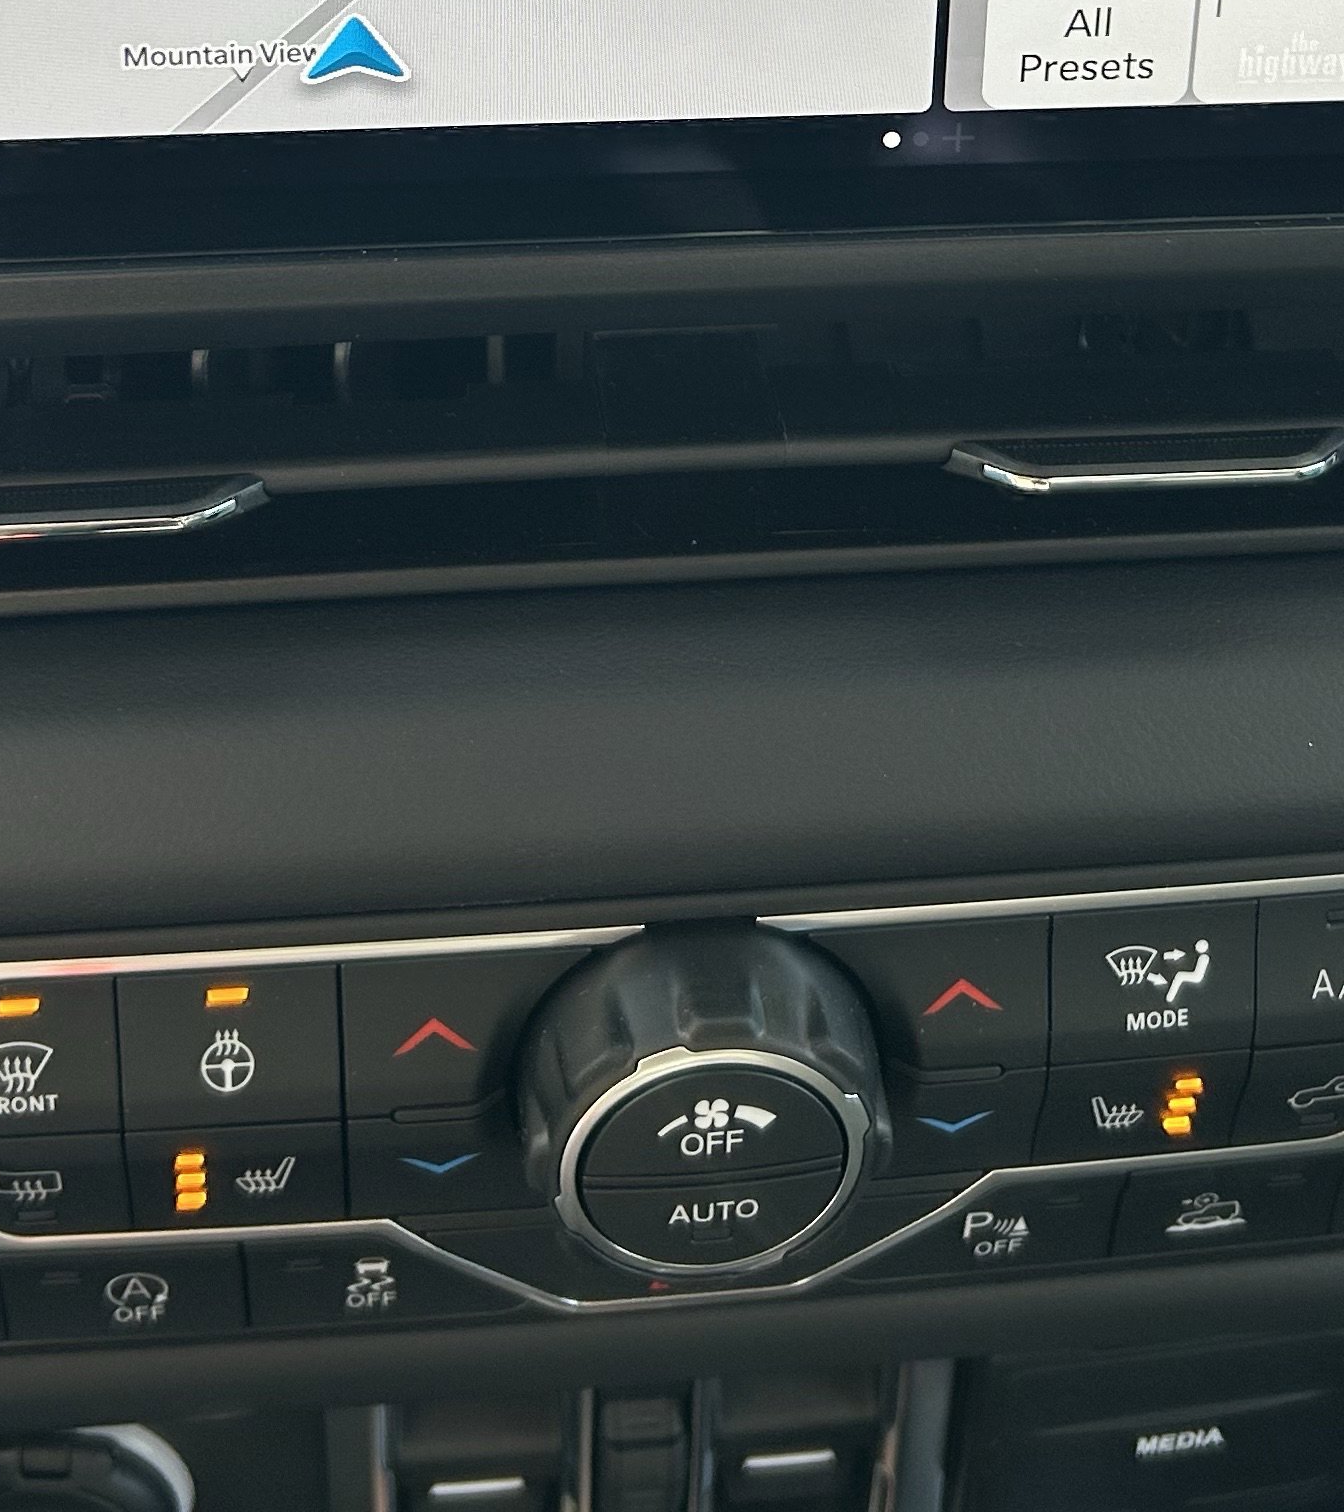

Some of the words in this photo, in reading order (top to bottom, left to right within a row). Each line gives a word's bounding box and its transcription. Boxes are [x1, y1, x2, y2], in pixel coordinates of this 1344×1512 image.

[1064, 7, 1112, 38] All
[124, 44, 253, 67] Mountain
[1020, 52, 1154, 83] Presets
[1126, 1009, 1189, 1031] MODE
[680, 1129, 744, 1157] OFF
[668, 1198, 759, 1225] AUTO
[973, 1237, 1024, 1256] OFF
[346, 1290, 397, 1308] OFF
[114, 1305, 165, 1323] OFF
[1135, 1426, 1225, 1457] MEDIA
